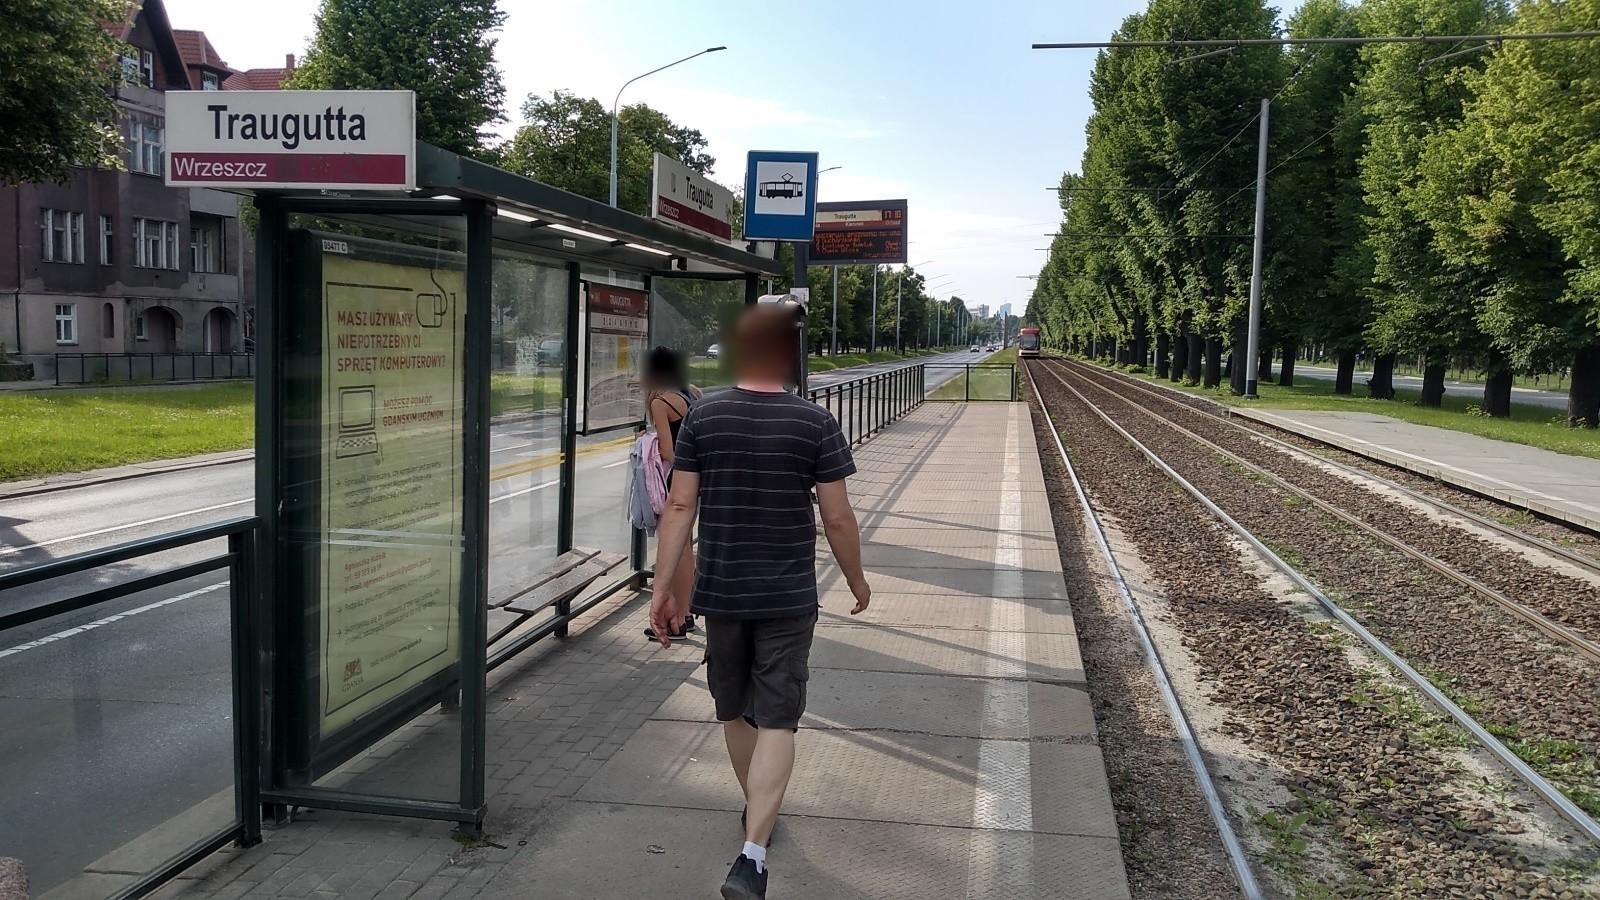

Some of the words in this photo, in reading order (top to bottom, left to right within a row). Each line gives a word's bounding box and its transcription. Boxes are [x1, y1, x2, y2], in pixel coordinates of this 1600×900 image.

[207, 104, 366, 149] Traugutta
[174, 157, 267, 177] Wrzeszcz
[686, 176, 713, 210] Traugutta
[337, 310, 368, 326] MASZ
[370, 308, 414, 327] UŻYWANY
[337, 334, 411, 349] NIEPOTRZEBNY
[413, 334, 421, 348] CI
[337, 356, 377, 374] SPRZĘT
[379, 354, 446, 371] KOMPUTEROWY?
